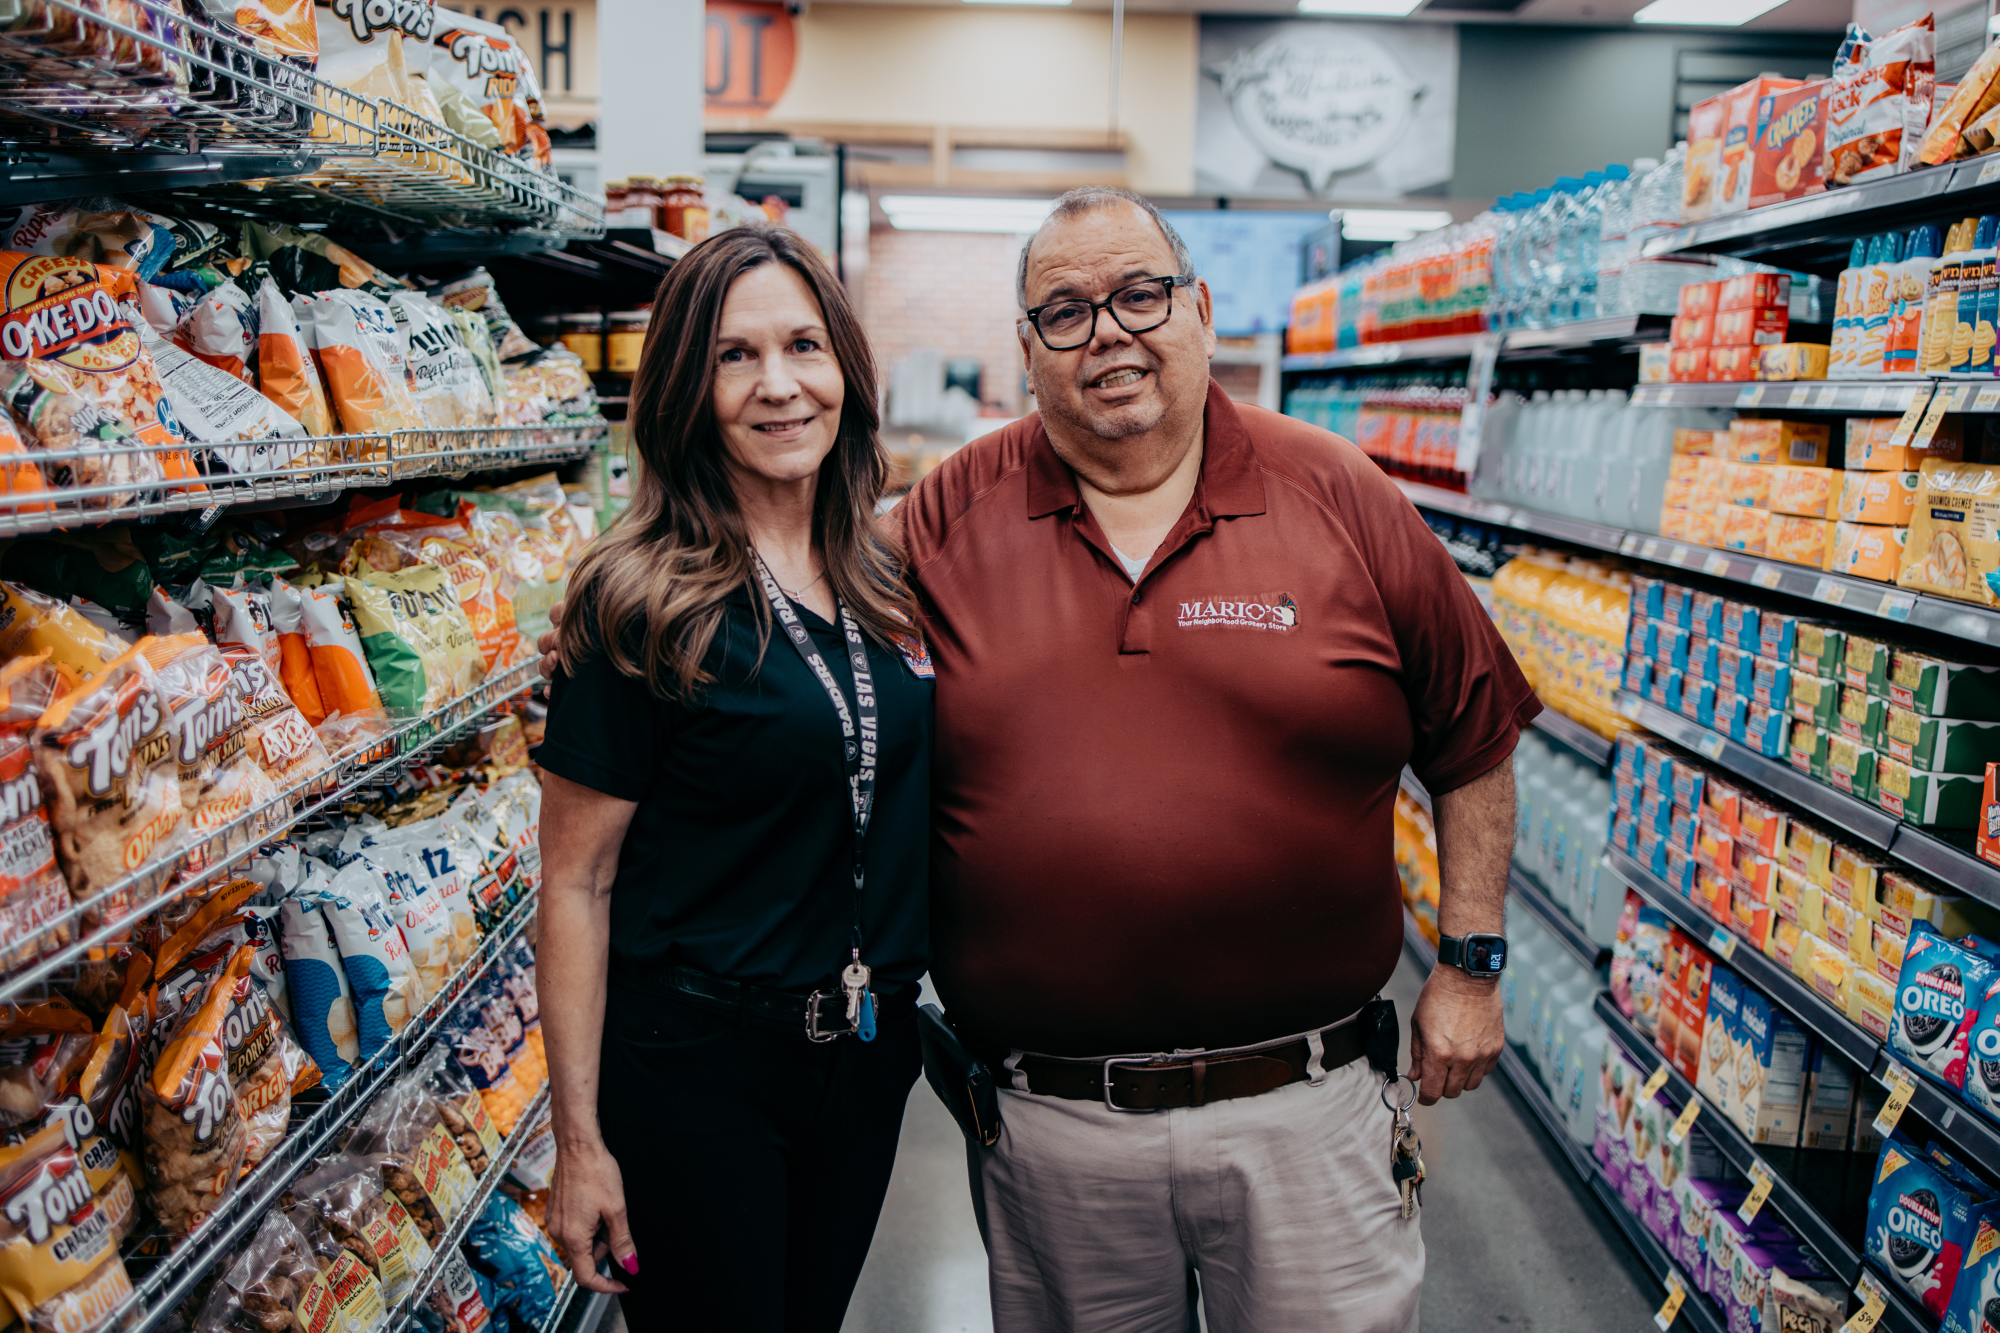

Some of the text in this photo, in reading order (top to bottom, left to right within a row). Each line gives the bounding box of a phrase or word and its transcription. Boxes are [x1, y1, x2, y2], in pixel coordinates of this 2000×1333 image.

[449, 33, 519, 79] Tom
[25, 303, 45, 315] WHEN
[58, 289, 77, 304] MORE
[77, 282, 96, 297] THAN
[1178, 601, 1285, 623] MARIO'S
[1193, 617, 1239, 626] Neighborhood
[1239, 619, 1267, 630] Grocery
[1268, 622, 1287, 631] Store
[807, 652, 856, 738] RAIDERS
[70, 691, 161, 793] Tom's
[173, 687, 242, 763] Tom's
[260, 716, 313, 767] BBQ
[853, 671, 878, 783] LAS VEGAS
[20, 897, 68, 935] SAUCE
[1901, 985, 1965, 1020] OREO
[1915, 971, 1963, 998] DOUBLE STUF
[6, 1166, 93, 1244] Tom
[1899, 1193, 1942, 1226] DOUBLE STUF
[1887, 1206, 1943, 1252] OREO
[1979, 1241, 1994, 1256] SIZE
[55, 1264, 134, 1333] ORIGIN
[1780, 1304, 1821, 1333] Pecan
